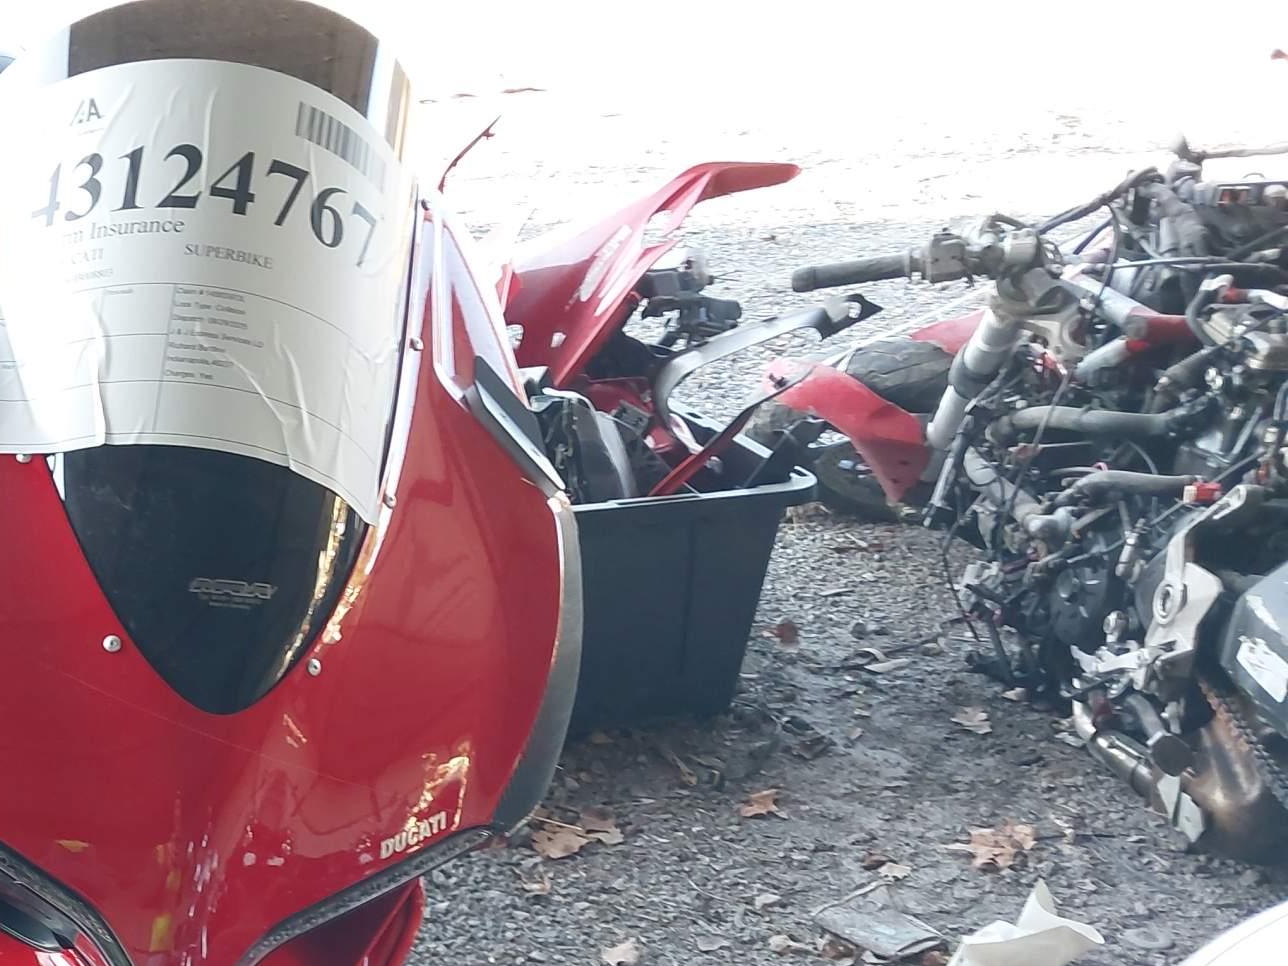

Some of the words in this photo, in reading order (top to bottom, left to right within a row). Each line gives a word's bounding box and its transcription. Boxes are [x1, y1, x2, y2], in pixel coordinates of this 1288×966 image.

[31, 142, 378, 268] 43124767
[90, 218, 186, 239] Insurance
[183, 242, 273, 271] SUPERBIKE
[379, 810, 448, 860] DUCATI
